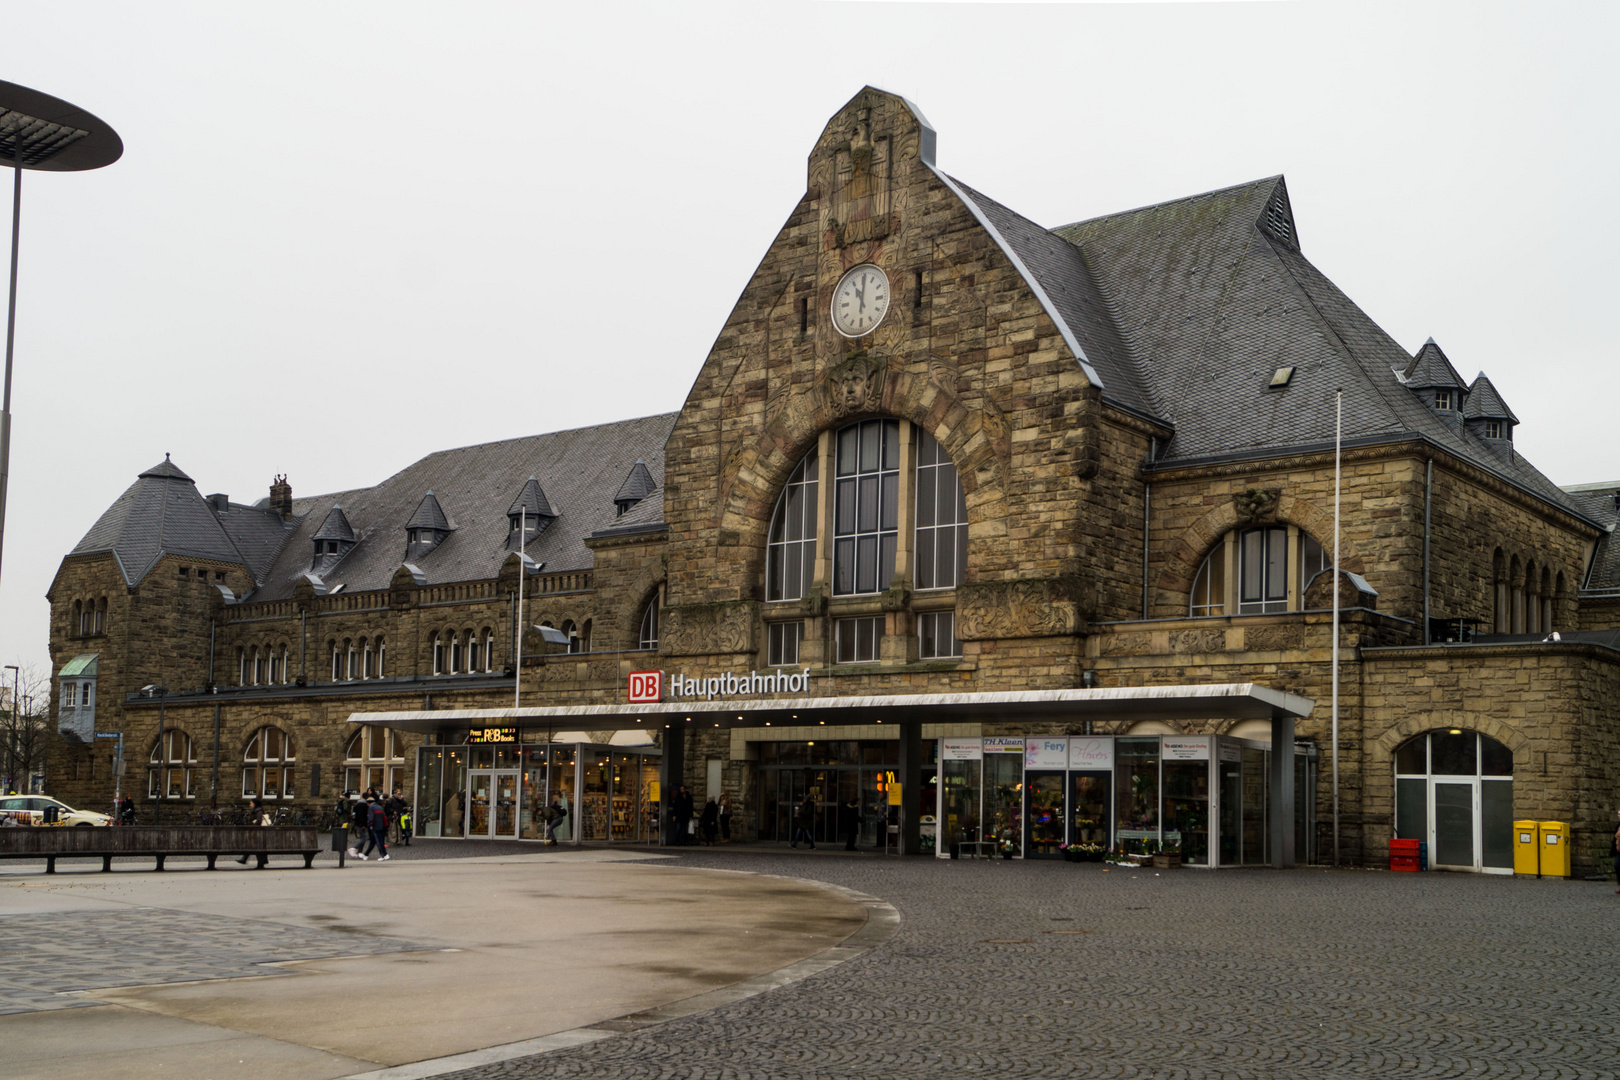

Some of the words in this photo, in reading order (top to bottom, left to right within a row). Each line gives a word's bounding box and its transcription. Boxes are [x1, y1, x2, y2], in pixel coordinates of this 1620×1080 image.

[632, 675, 657, 698] DB
[671, 667, 811, 701] Hauptbahnhof
[1044, 741, 1066, 752] Fery
[1071, 740, 1111, 760] Flowers
